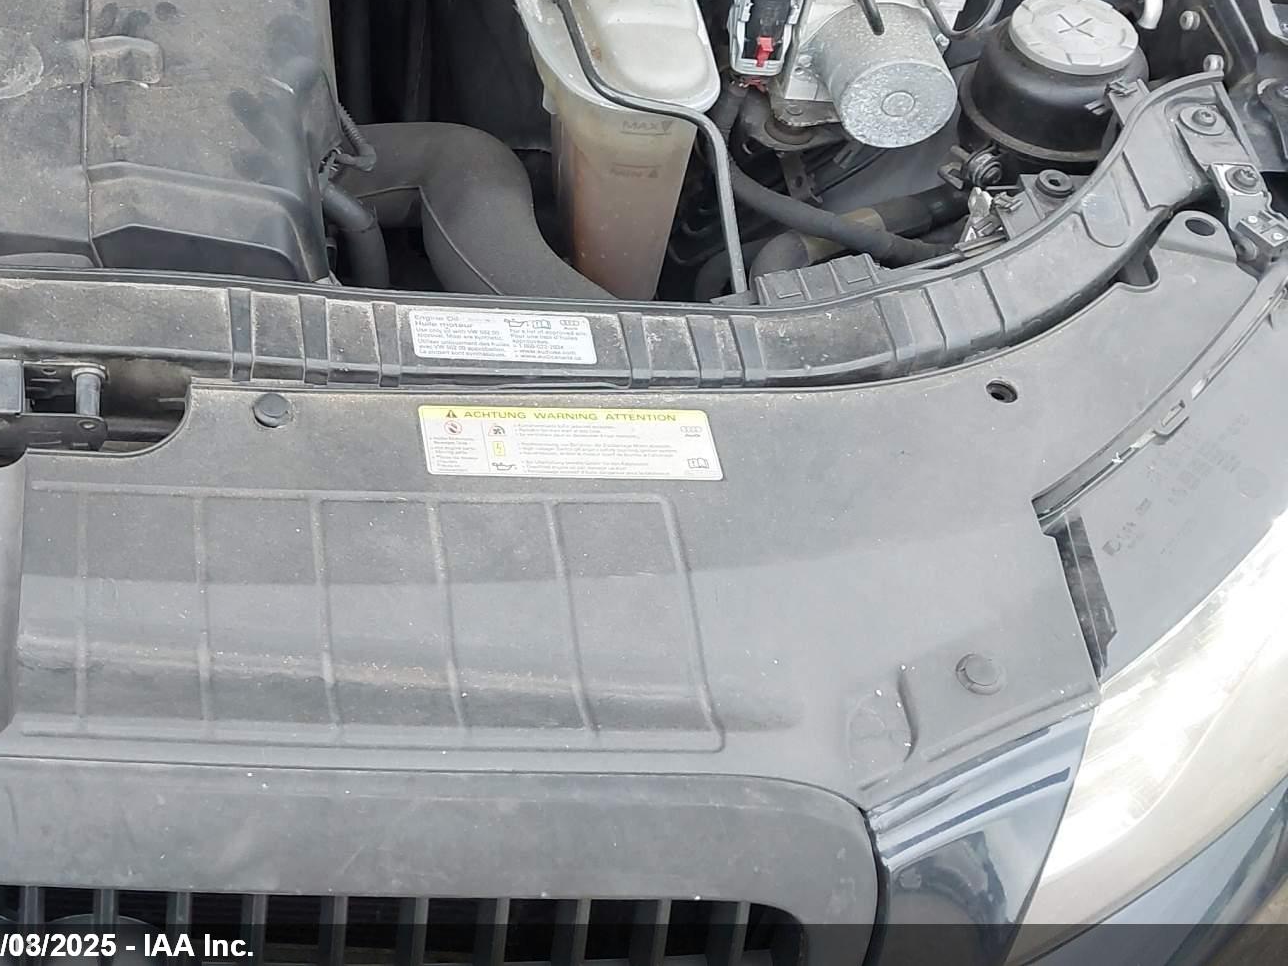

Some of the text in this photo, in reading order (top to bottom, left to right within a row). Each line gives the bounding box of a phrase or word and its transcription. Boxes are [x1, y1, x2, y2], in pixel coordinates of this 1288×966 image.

[622, 120, 659, 131] MAX
[414, 314, 445, 322] Engine
[464, 410, 677, 422] ACHTUNG WARNING ATTENTION
